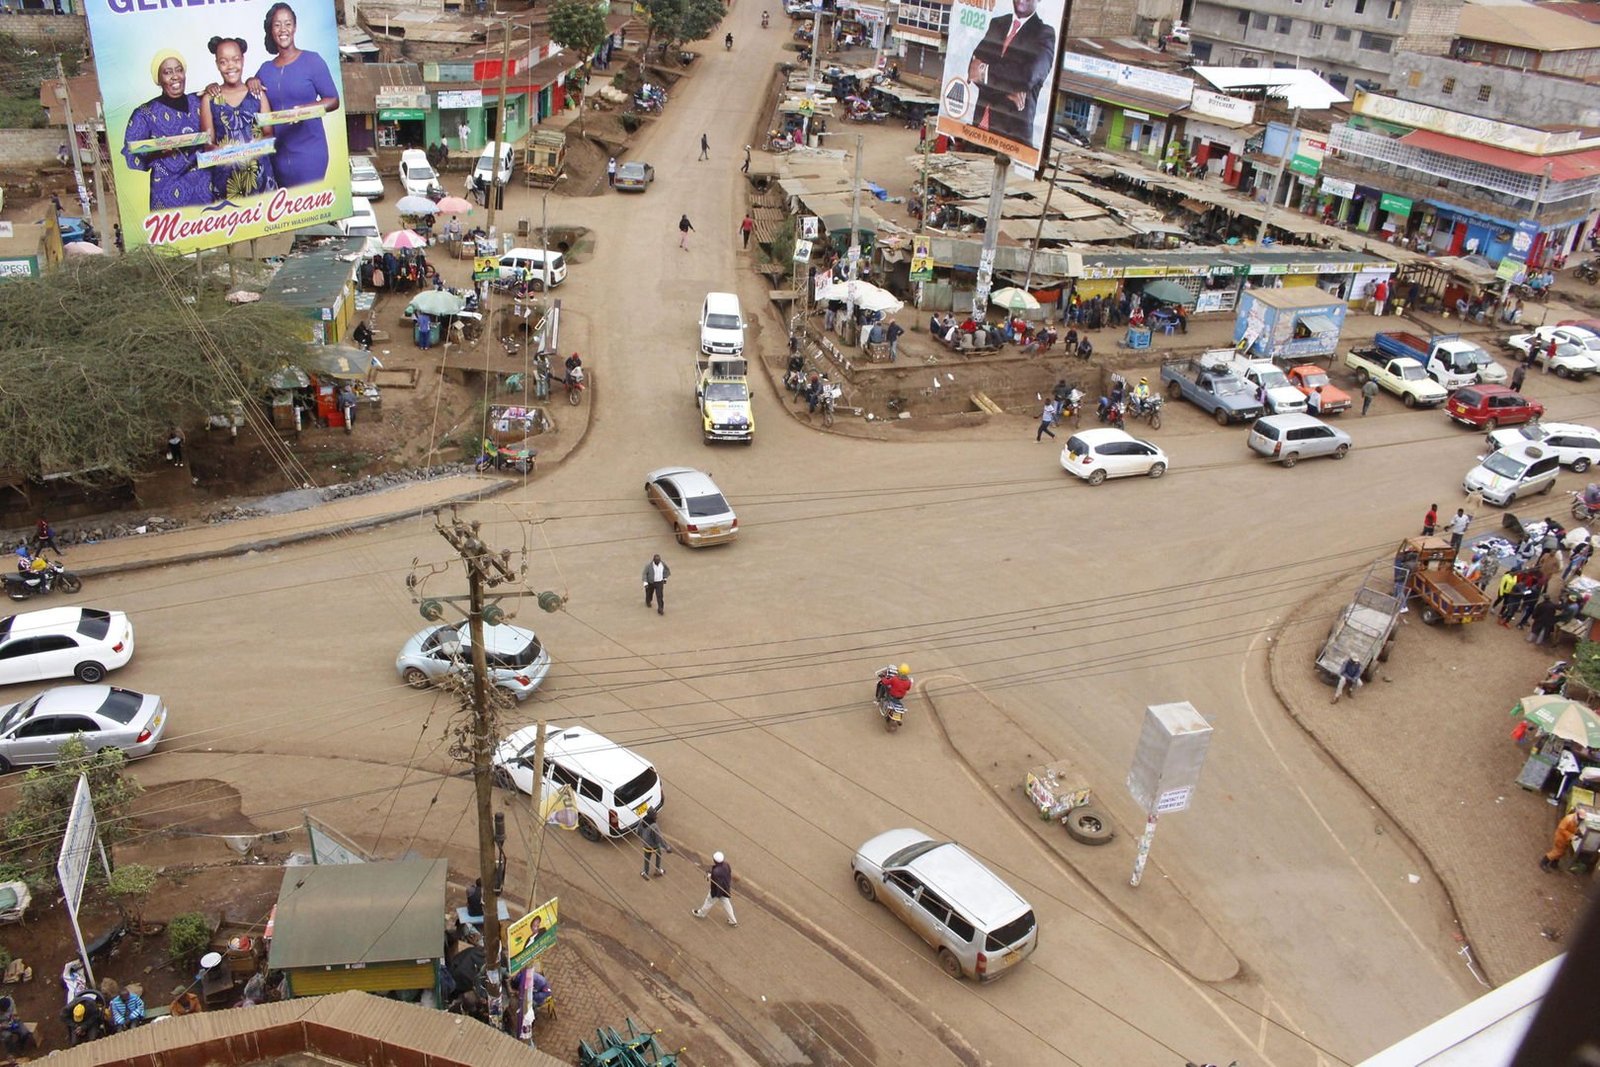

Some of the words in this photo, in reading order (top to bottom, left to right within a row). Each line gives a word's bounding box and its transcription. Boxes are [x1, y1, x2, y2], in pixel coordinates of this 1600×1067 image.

[960, 8, 986, 31] 2022
[145, 203, 262, 244] Menengai
[267, 188, 334, 222] Cream
[264, 222, 290, 232] QUALITY
[291, 214, 319, 226] WASHING
[320, 212, 332, 220] BAR
